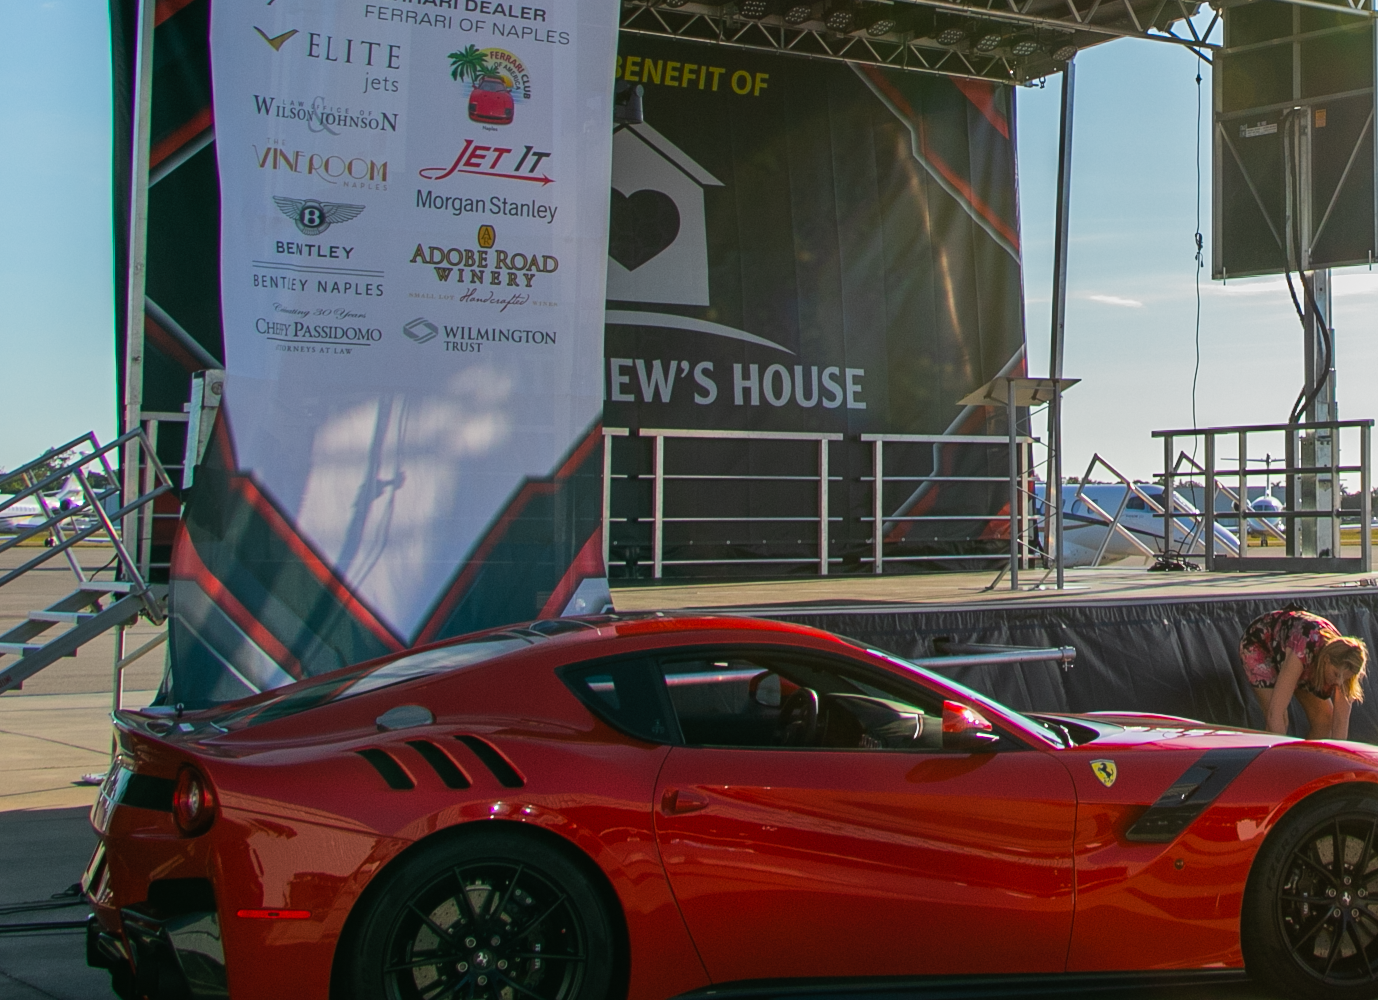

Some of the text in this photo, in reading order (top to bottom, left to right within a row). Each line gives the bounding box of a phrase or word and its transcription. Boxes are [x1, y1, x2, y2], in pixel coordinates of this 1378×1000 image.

[364, 4, 571, 46] FERRARI OF NAPLES
[307, 32, 401, 70] ELITE
[363, 71, 399, 94] jets
[490, 51, 531, 100] FERRARI CLUB
[503, 65, 521, 91] AMERICA
[731, 69, 769, 97] OF
[282, 99, 304, 107] LAW
[359, 109, 373, 117] OF
[252, 144, 388, 184] VINE ROOM
[424, 138, 512, 179] JET
[343, 181, 388, 191] NAPLES
[415, 189, 558, 224] Morgan Stanley
[276, 241, 354, 259] BENTLEY
[409, 243, 559, 273] ADOBE ROAD
[253, 274, 384, 297] BENTLEY NAPLES
[433, 266, 536, 288] WINERY
[459, 288, 530, 312] Handcrafted
[293, 321, 383, 341] PASSIDOMO
[443, 325, 557, 345] WILMINGTON
[319, 346, 331, 354] AT
[333, 347, 353, 355] LAW
[443, 340, 483, 353] TRUST
[733, 363, 867, 410] HOUSE
